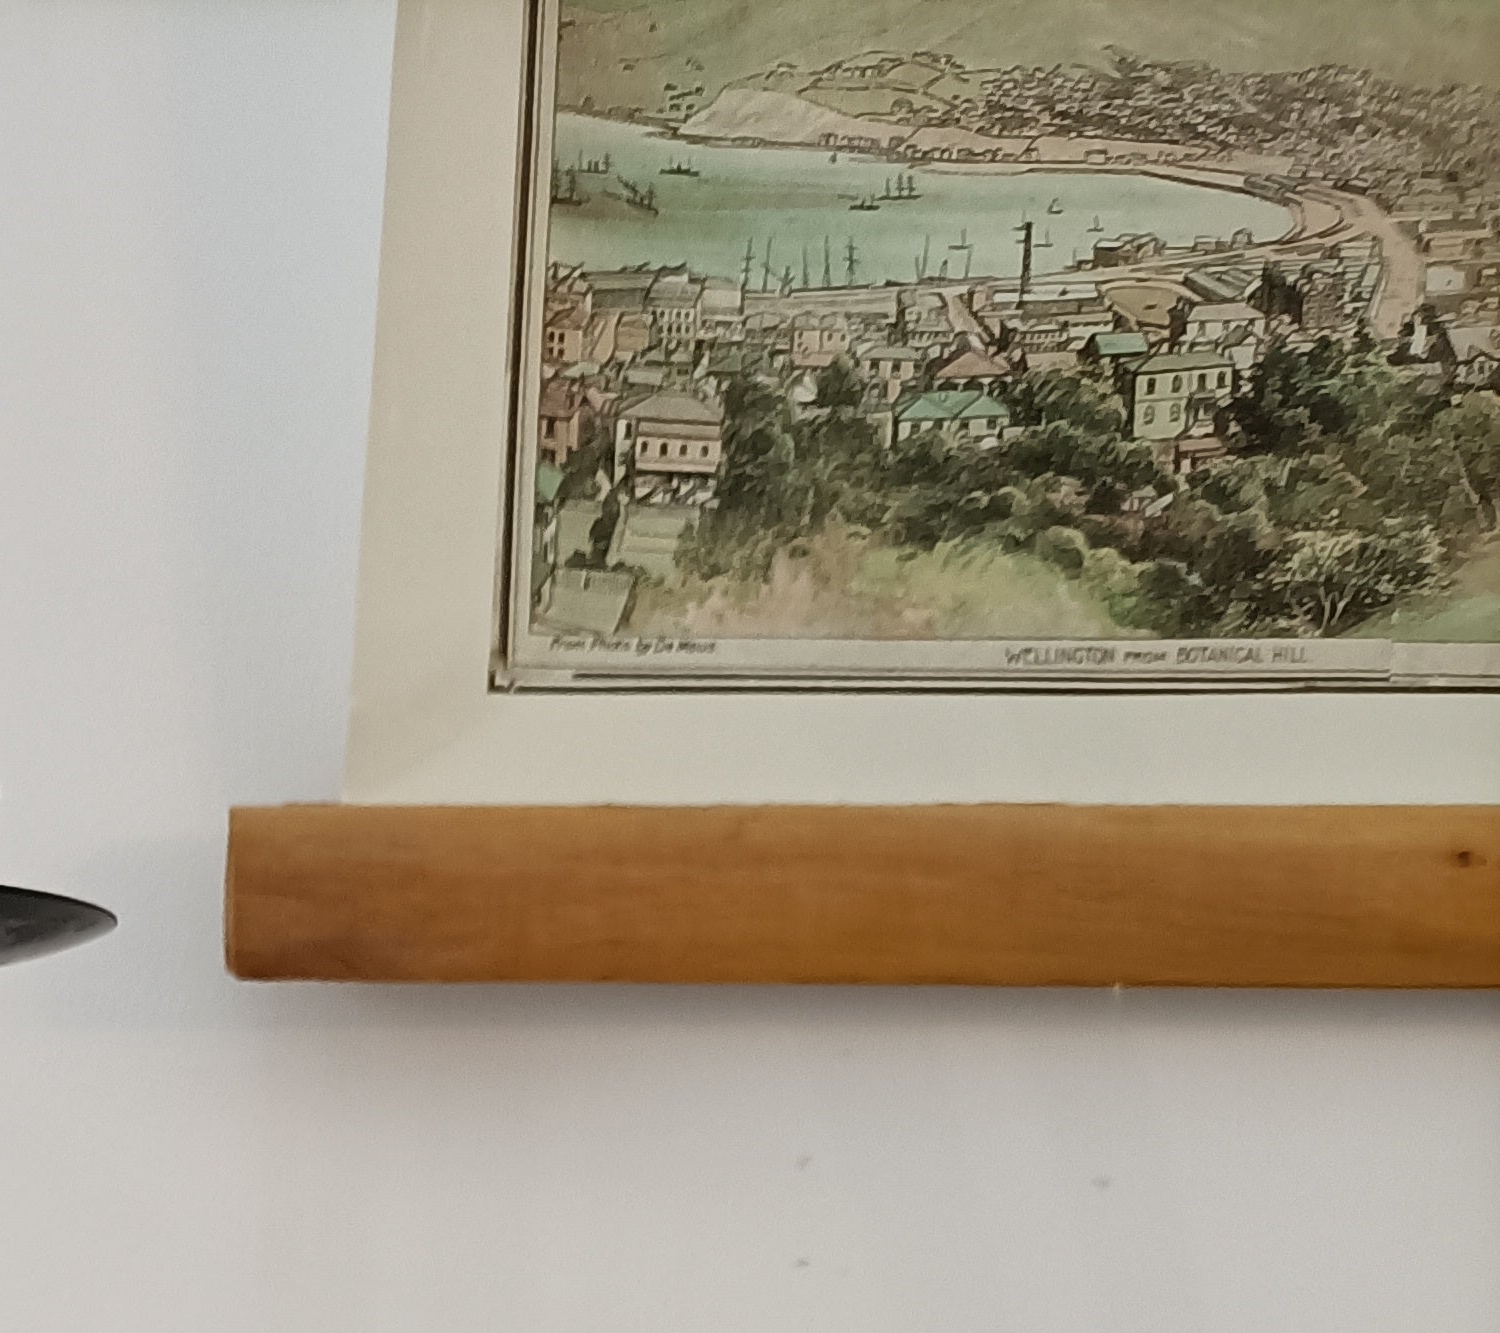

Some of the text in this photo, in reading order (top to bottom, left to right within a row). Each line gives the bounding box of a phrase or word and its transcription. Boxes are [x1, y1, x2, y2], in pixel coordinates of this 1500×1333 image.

[1004, 645, 1115, 666] WELLINGTON
[1175, 645, 1264, 665] BOTANICAL
[1271, 645, 1308, 664] HILL
